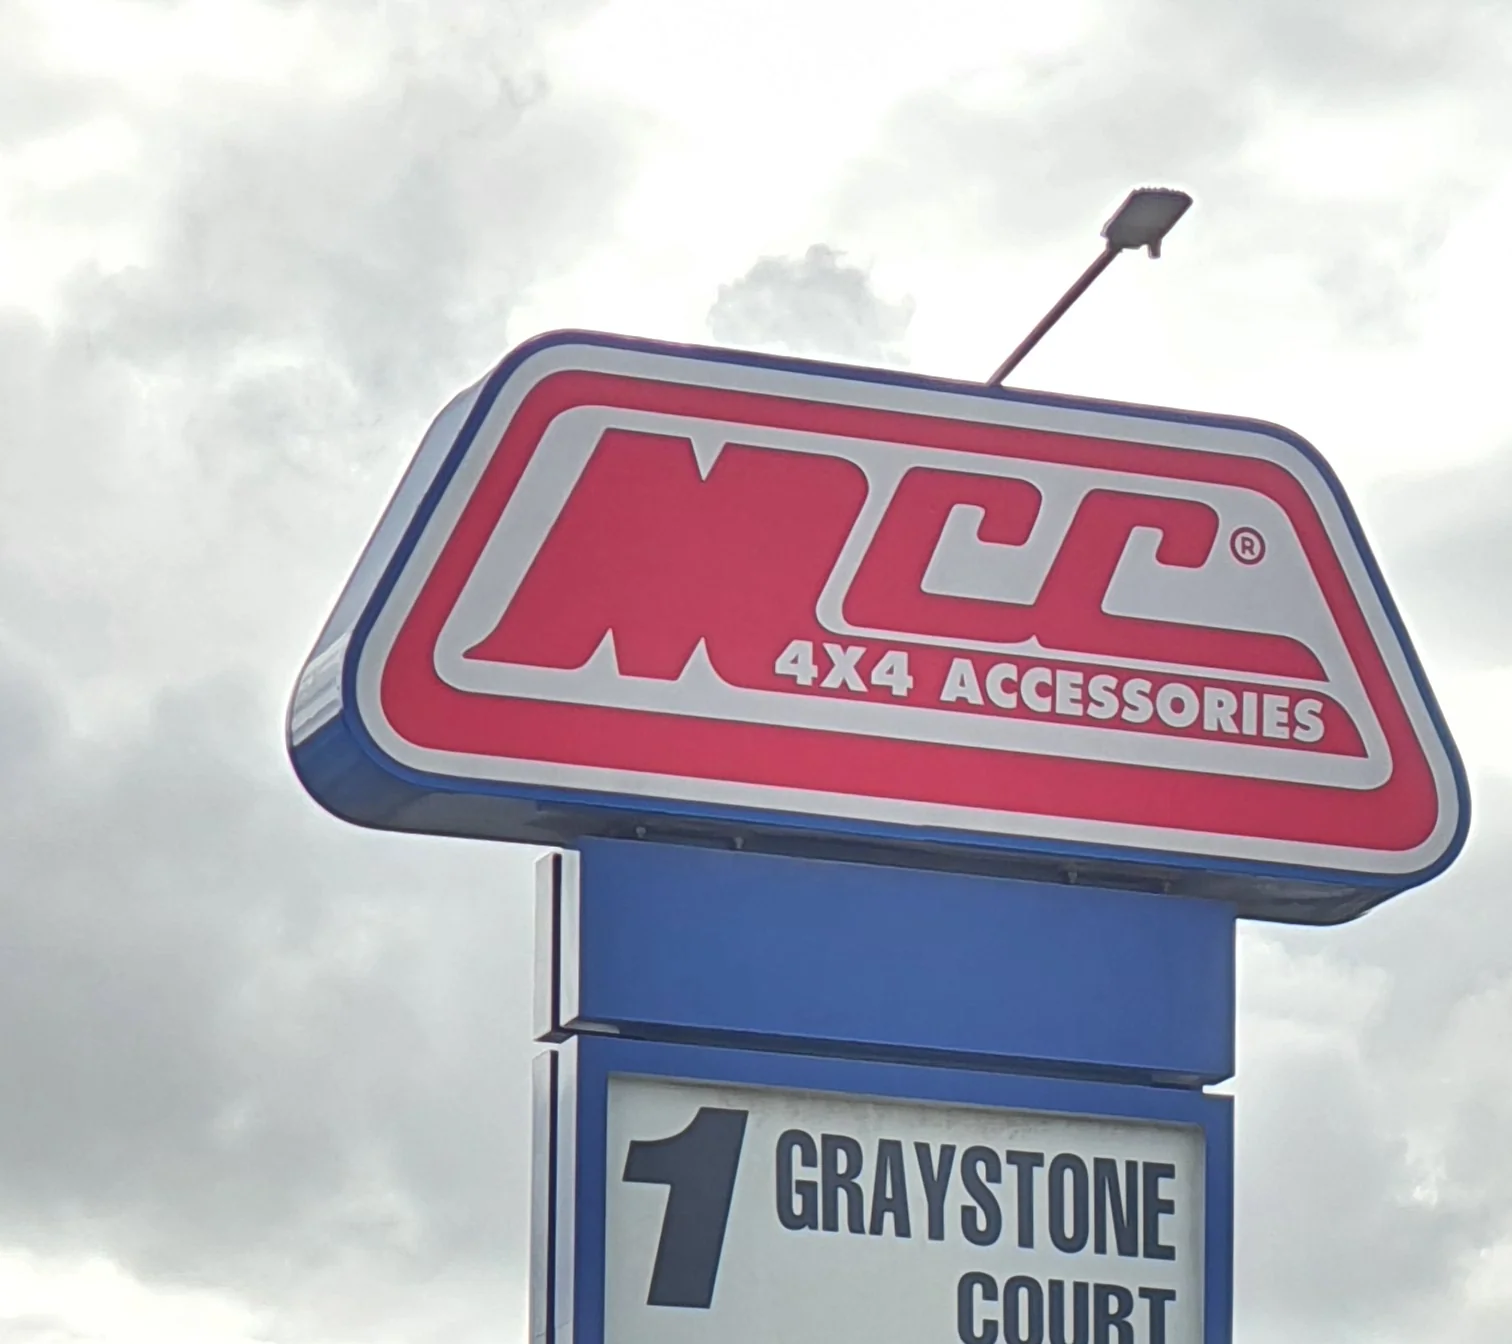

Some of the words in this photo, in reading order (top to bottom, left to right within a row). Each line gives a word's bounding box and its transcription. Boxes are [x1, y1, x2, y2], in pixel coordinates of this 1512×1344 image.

[460, 427, 1331, 690] MCC
[774, 639, 914, 697] 4X4
[940, 658, 1325, 743] ACCESSORIES
[622, 1106, 749, 1310] 1
[775, 1128, 1177, 1262] GRAYSTONE
